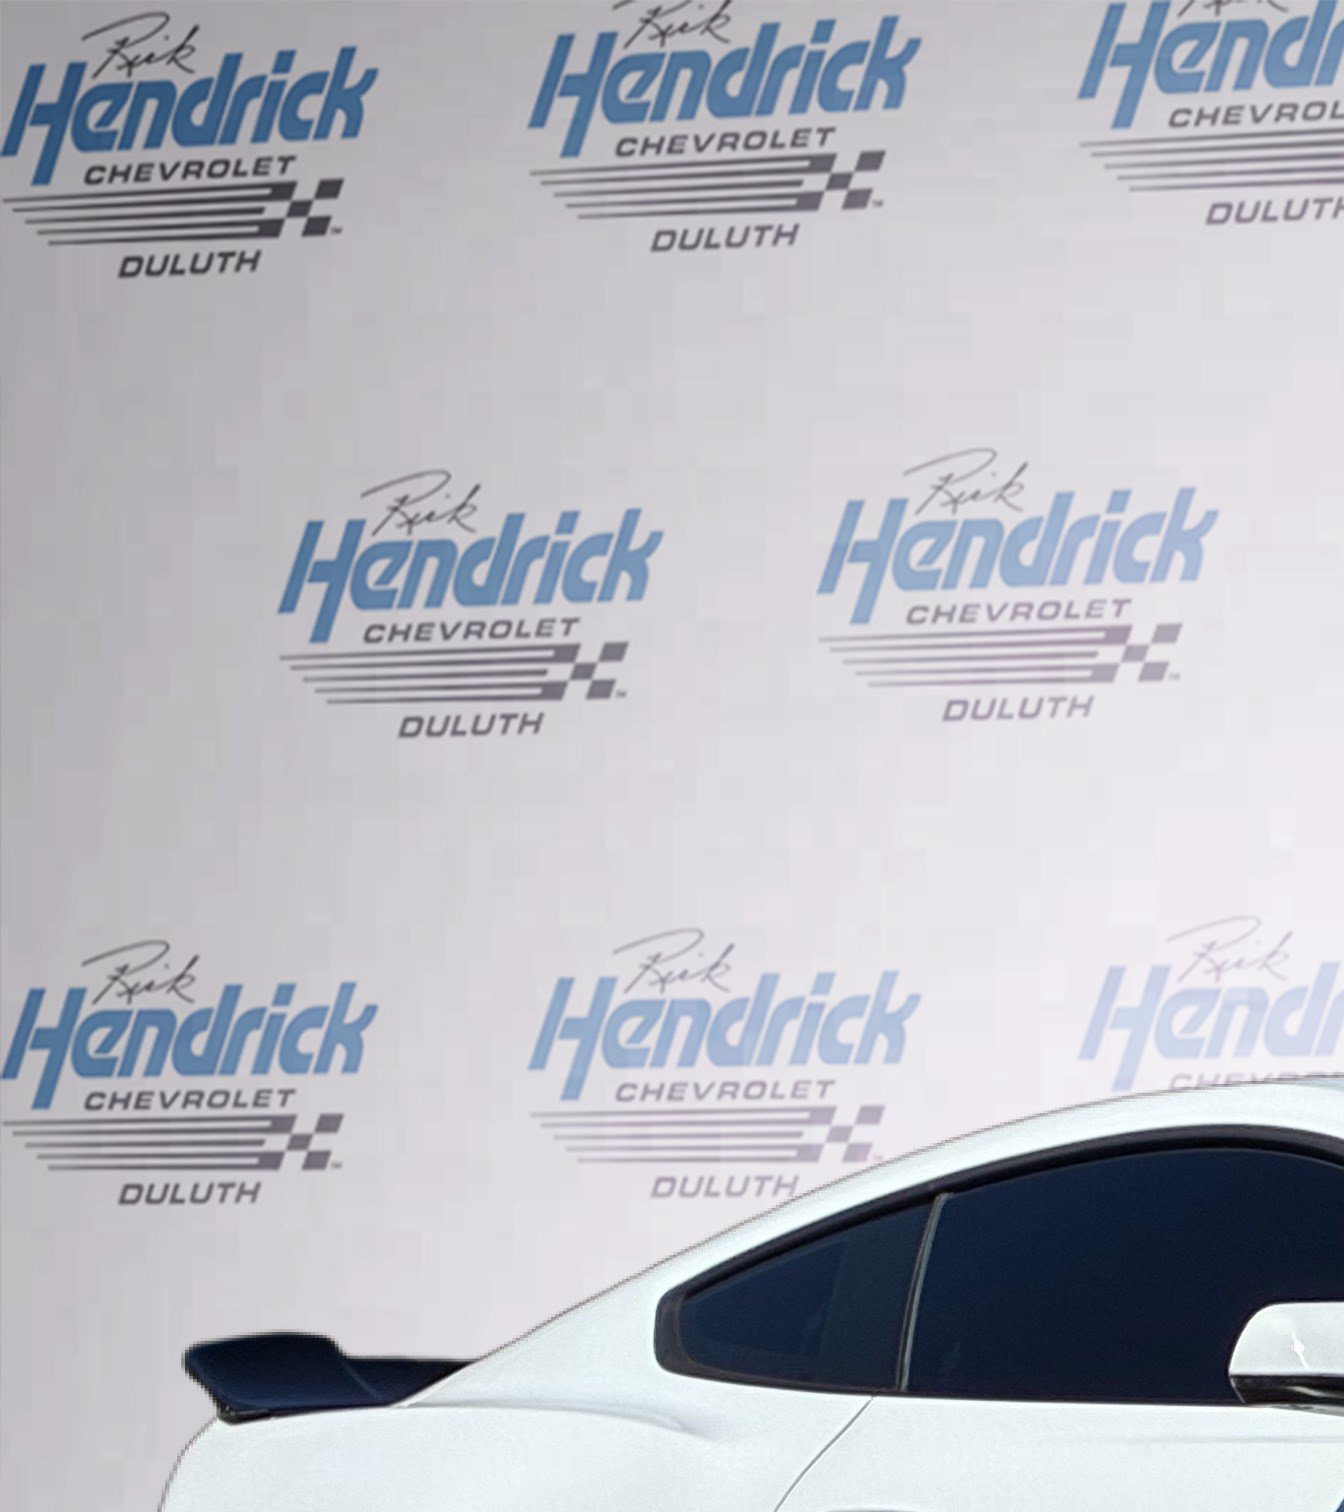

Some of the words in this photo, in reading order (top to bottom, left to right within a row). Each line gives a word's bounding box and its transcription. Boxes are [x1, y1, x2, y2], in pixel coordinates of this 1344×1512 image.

[528, 13, 923, 160] Hendrick
[0, 45, 380, 186] Hendrick
[614, 126, 837, 158] CHEVROLET
[83, 154, 298, 187] CHEVROLET
[650, 222, 801, 253] DULUTH
[117, 250, 261, 280] DULUTH
[816, 486, 1220, 626] Hendrick
[276, 507, 665, 645] Hendrick
[905, 598, 1132, 626] CHEVROLET
[362, 616, 581, 645] CHEVROLET
[941, 695, 1095, 722] DULUTH
[397, 711, 546, 739] DULUTH
[0, 979, 380, 1112] Hendrick
[528, 969, 921, 1103] Hendrick
[83, 1088, 297, 1112] CHEVROLET
[615, 1079, 836, 1103] CHEVROLET
[117, 1181, 262, 1206] DULUTH
[650, 1174, 800, 1199] DULUTH
